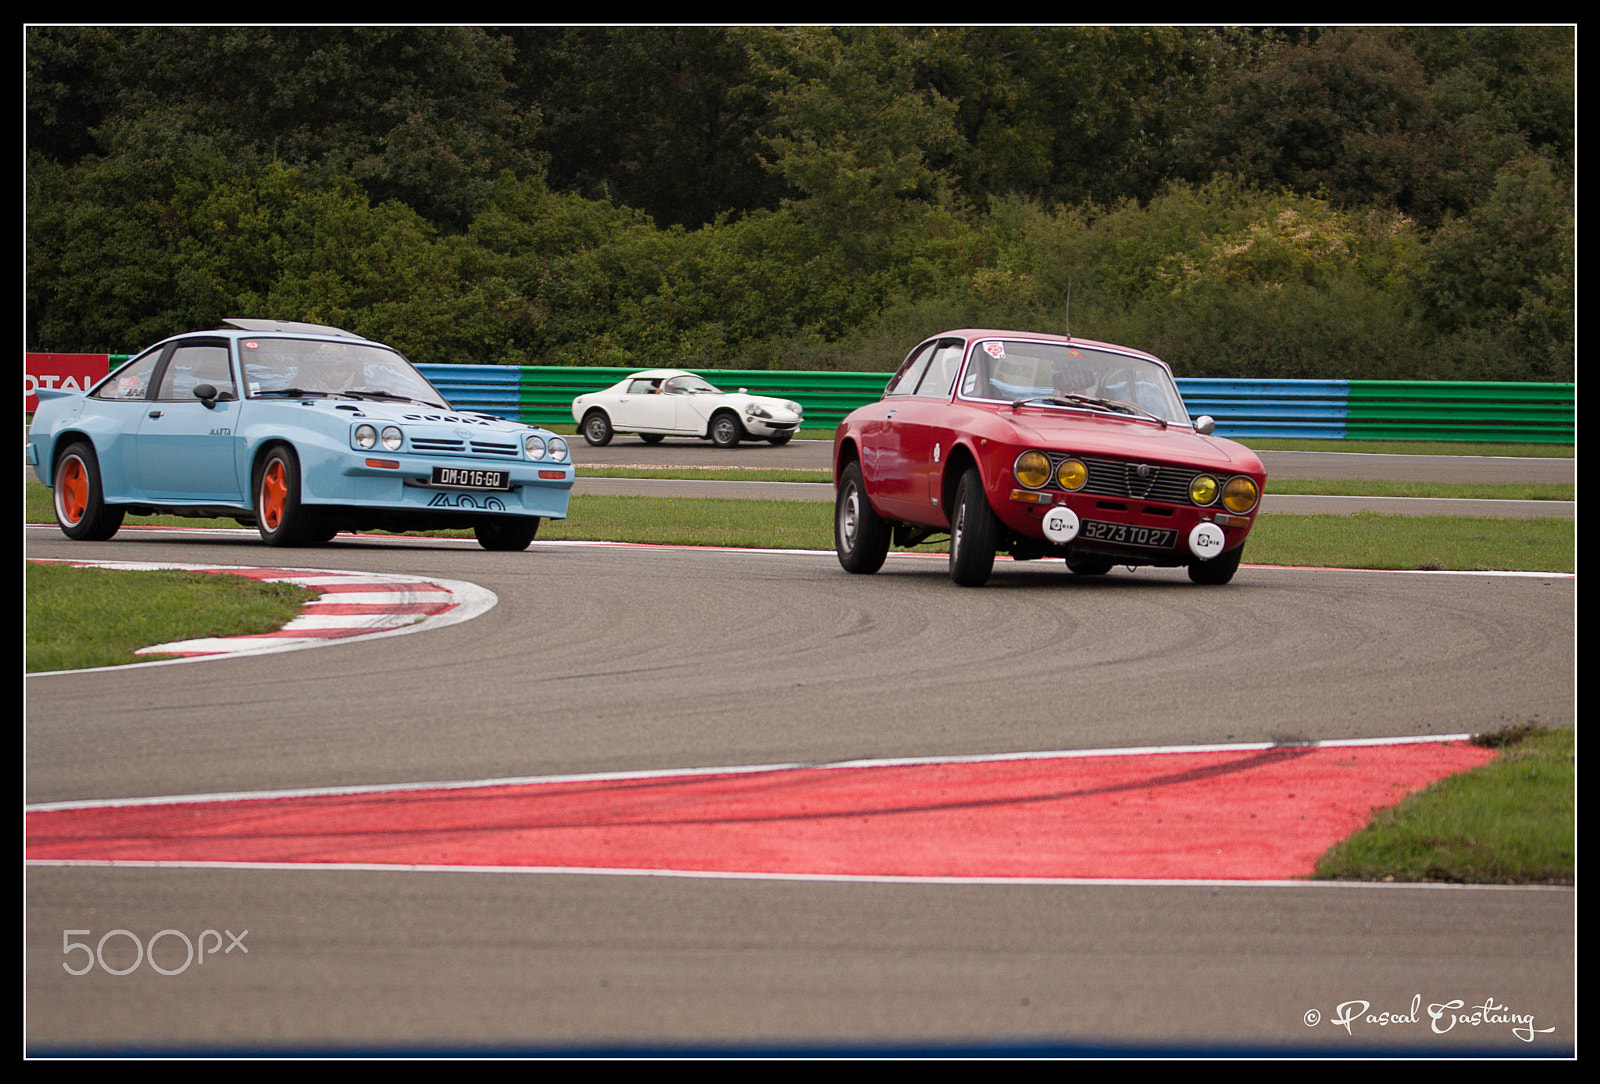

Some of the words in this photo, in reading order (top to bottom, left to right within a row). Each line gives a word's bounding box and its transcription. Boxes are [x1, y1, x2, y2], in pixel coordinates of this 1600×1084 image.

[441, 468, 501, 487] DM-016-GQ
[1085, 522, 1127, 542] 5273
[1150, 530, 1171, 546] 27
